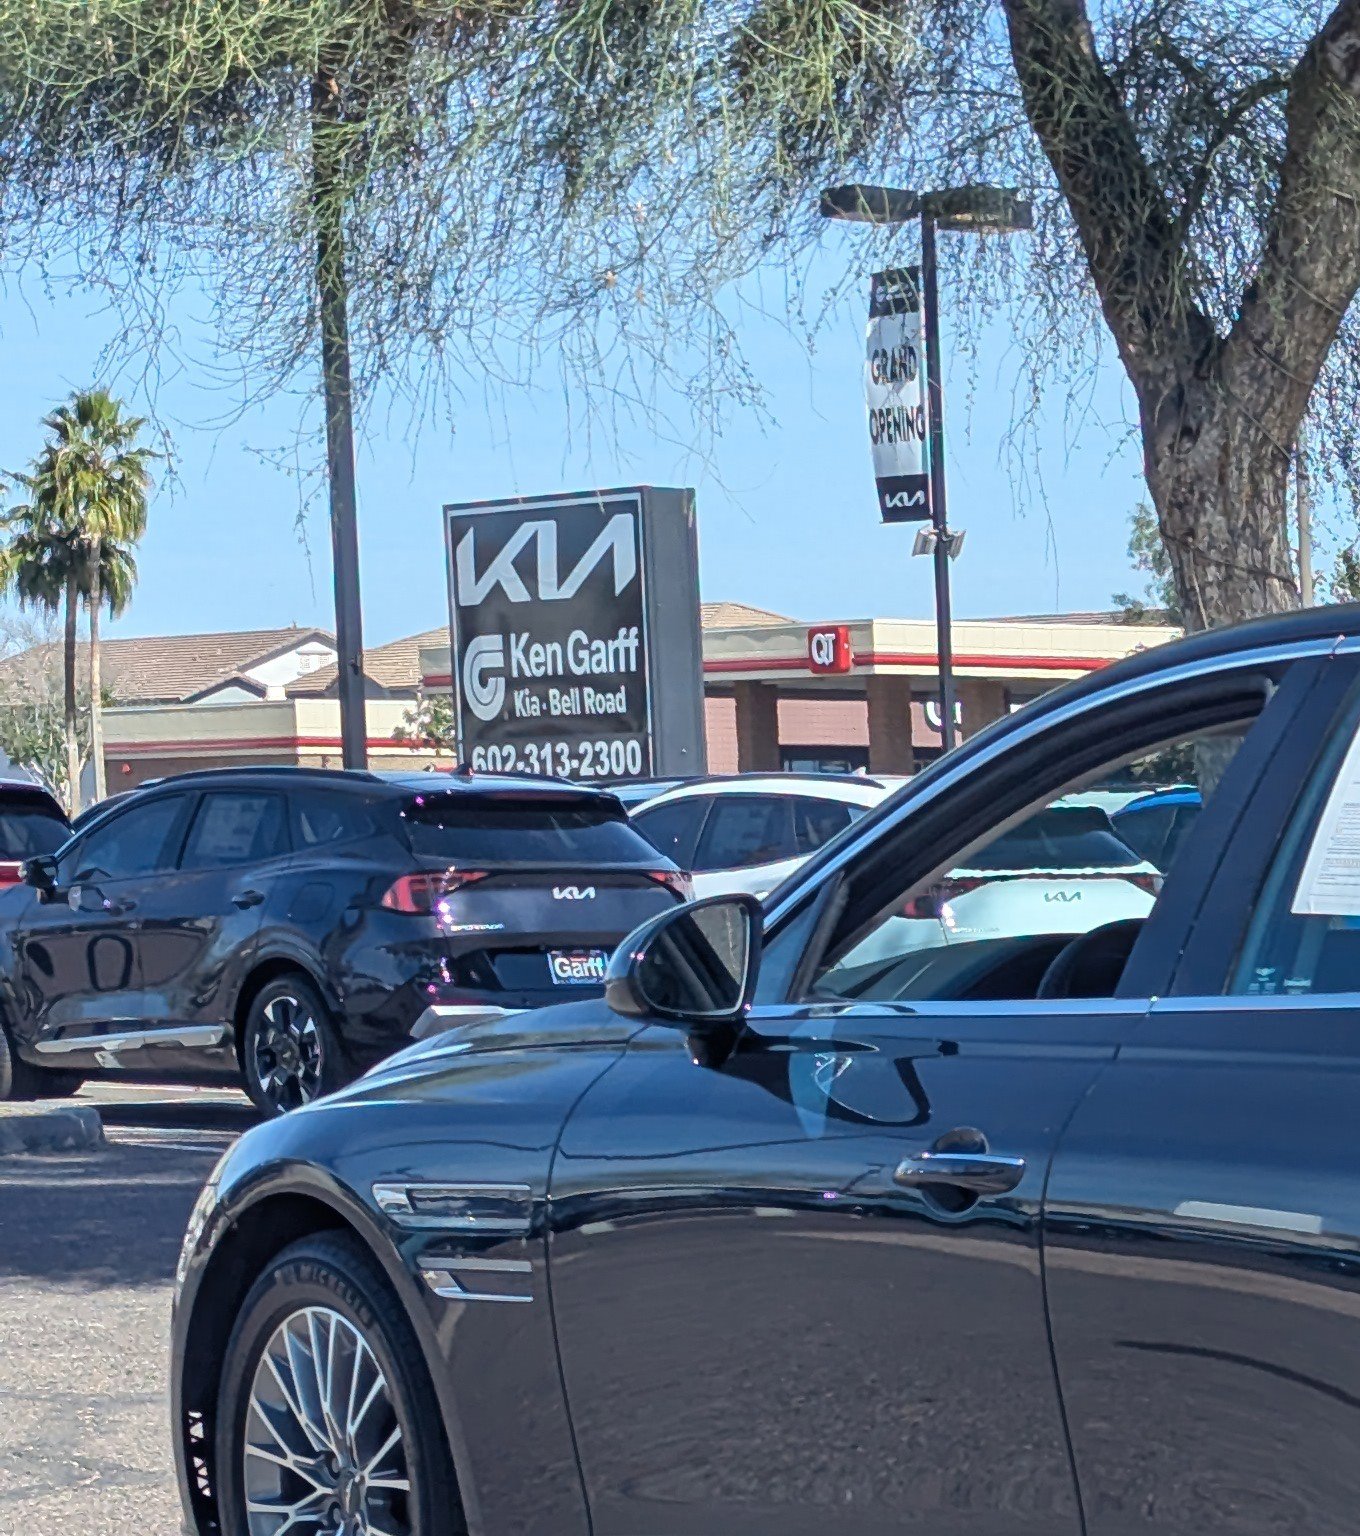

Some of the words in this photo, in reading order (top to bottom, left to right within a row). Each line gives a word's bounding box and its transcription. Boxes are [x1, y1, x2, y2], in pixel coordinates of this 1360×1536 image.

[871, 345, 918, 385] GRAND
[869, 404, 926, 445] OPENING
[885, 490, 924, 508] KIA
[456, 513, 636, 606] KIA
[510, 632, 563, 678] Ken
[567, 626, 639, 676] Garff
[811, 633, 836, 666] QT
[514, 687, 541, 718] Kia
[549, 680, 581, 717] Bell
[584, 683, 627, 716] Road
[471, 739, 642, 777] 602-313-2300
[552, 886, 596, 900] KIA
[1044, 891, 1082, 903] KIA
[554, 957, 604, 977] Garff
